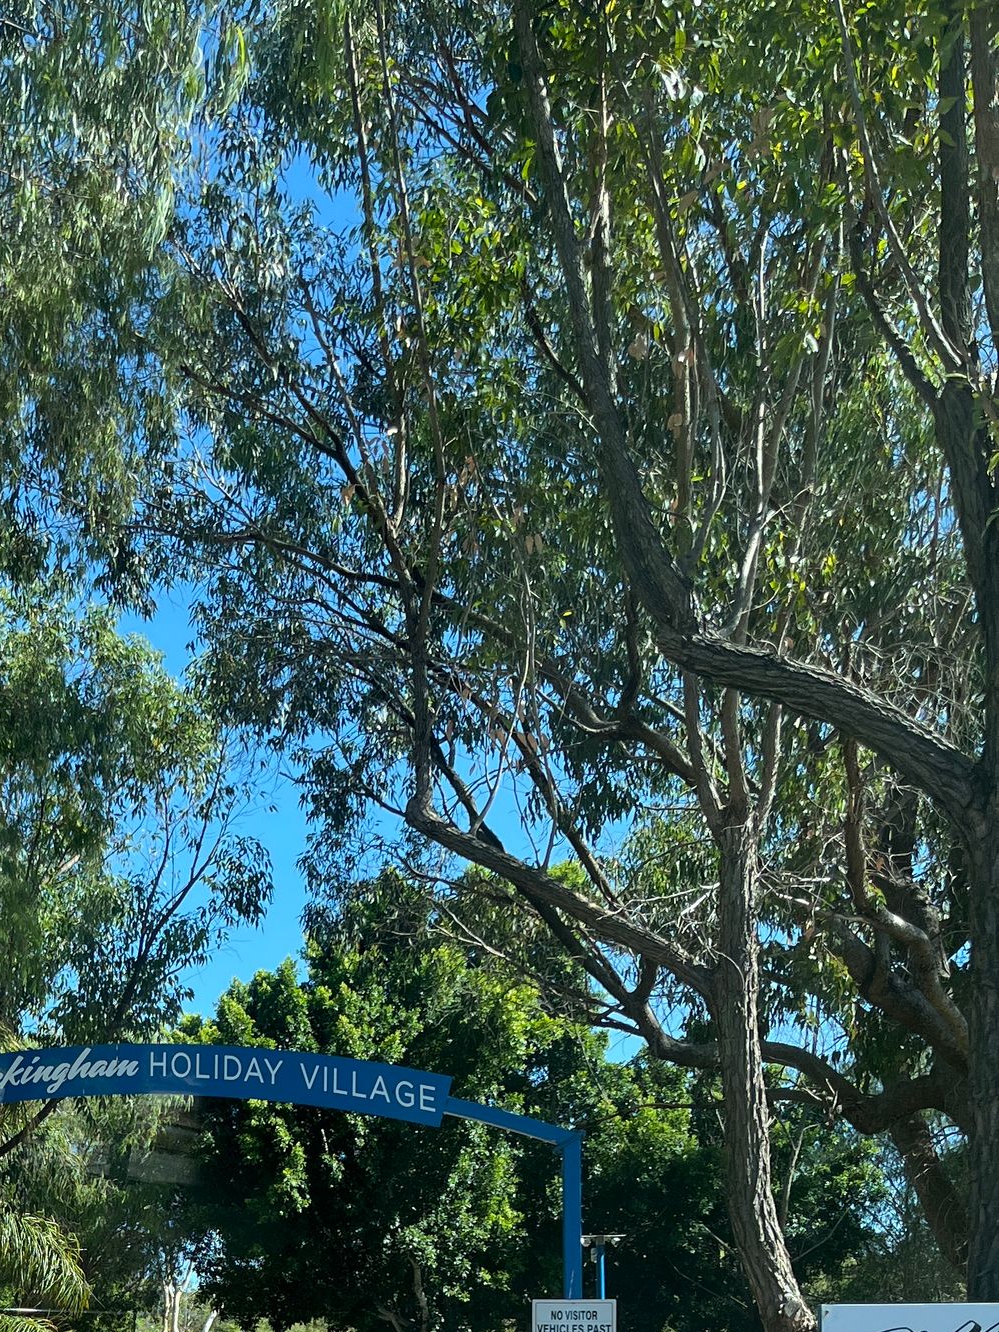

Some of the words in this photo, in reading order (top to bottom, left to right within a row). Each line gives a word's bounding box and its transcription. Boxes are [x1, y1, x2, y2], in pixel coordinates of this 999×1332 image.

[149, 1051, 284, 1085] HOLIDAY
[300, 1062, 437, 1113] VILLAGE
[550, 1310, 563, 1321] NO
[564, 1310, 598, 1321] VISITOR
